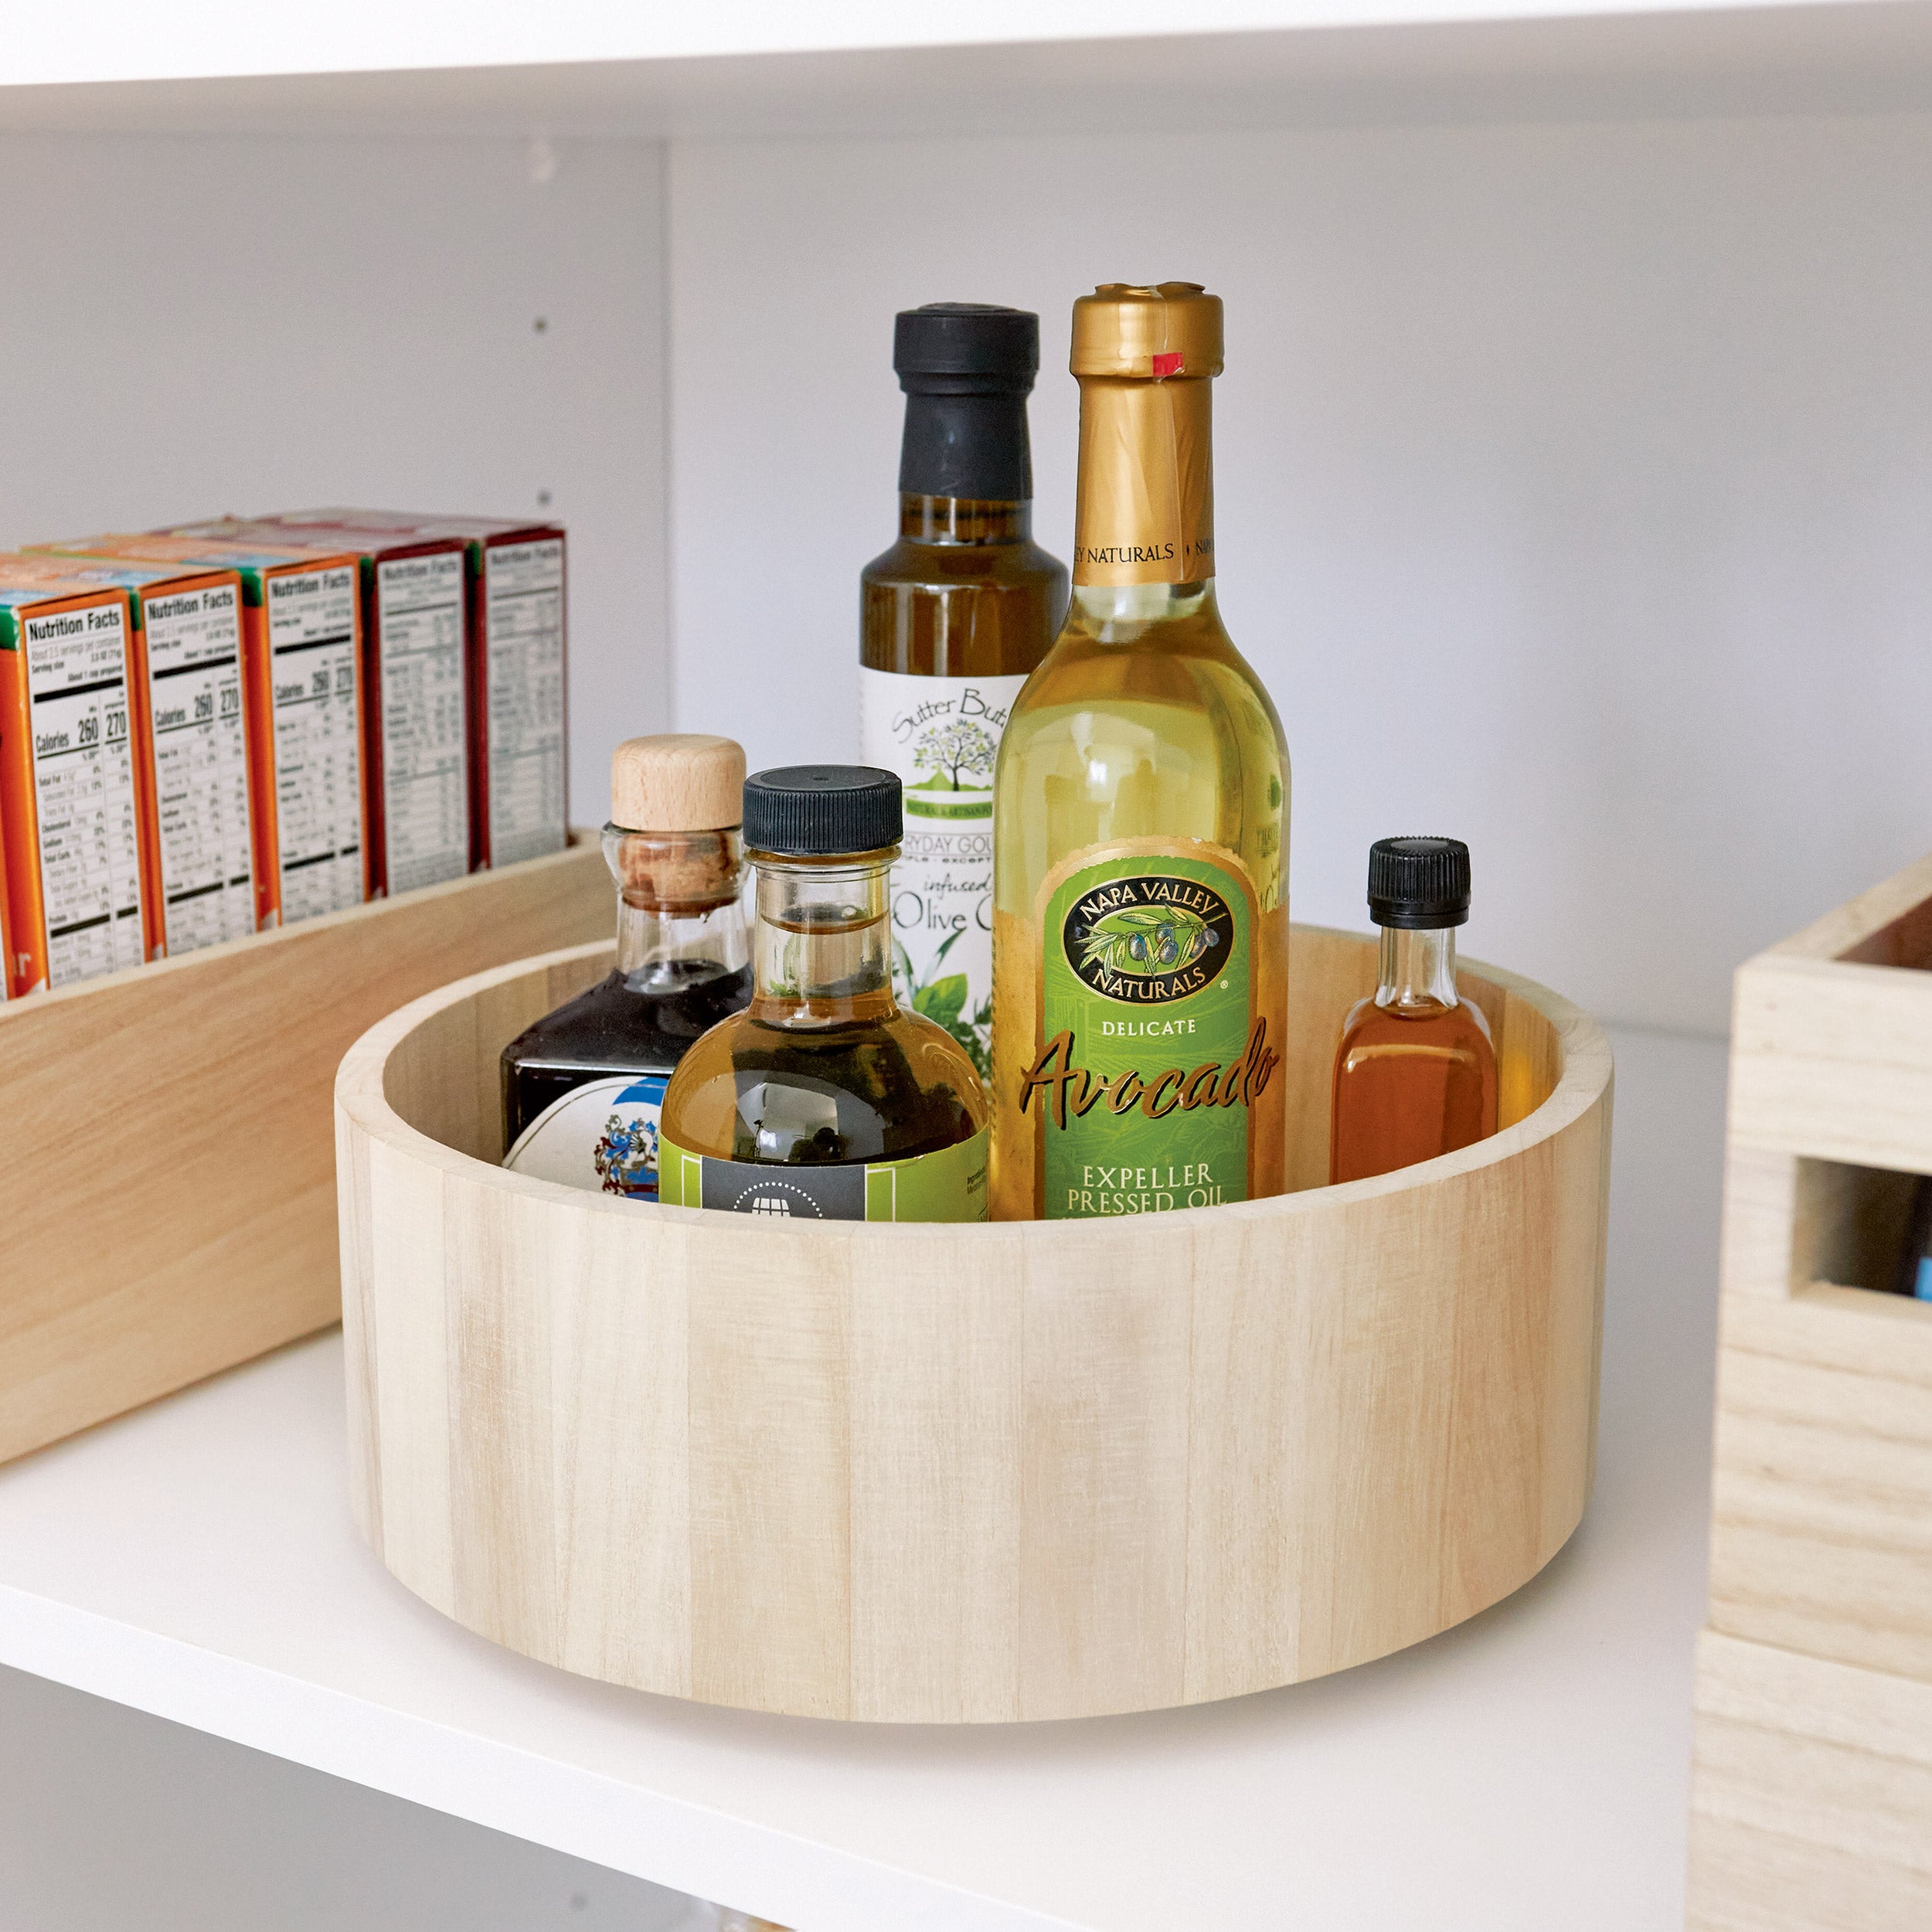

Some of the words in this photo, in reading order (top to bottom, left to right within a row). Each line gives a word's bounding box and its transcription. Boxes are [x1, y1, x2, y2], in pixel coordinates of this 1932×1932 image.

[1087, 543, 1174, 563] NATURALS
[148, 598, 199, 619] Nutrition
[202, 592, 233, 610] Facts
[29, 618, 83, 641] Nutrition
[87, 610, 121, 630] Facts
[220, 688, 239, 713] 270
[36, 732, 70, 752] Calories
[78, 717, 98, 743] 260
[106, 710, 127, 736] 270
[892, 699, 957, 744] Sutter
[923, 873, 992, 900] infused
[893, 891, 966, 930] Olive
[1080, 885, 1138, 921] NAPA
[1141, 883, 1219, 915] VALLEY
[1092, 967, 1206, 999] NATURALS
[1102, 1019, 1196, 1036] DELICATE
[1019, 1016, 1280, 1131] Avocado
[1083, 1163, 1213, 1189] EXPELLER
[1068, 1189, 1174, 1214] PRESSED
[1188, 1186, 1226, 1209] OIL
